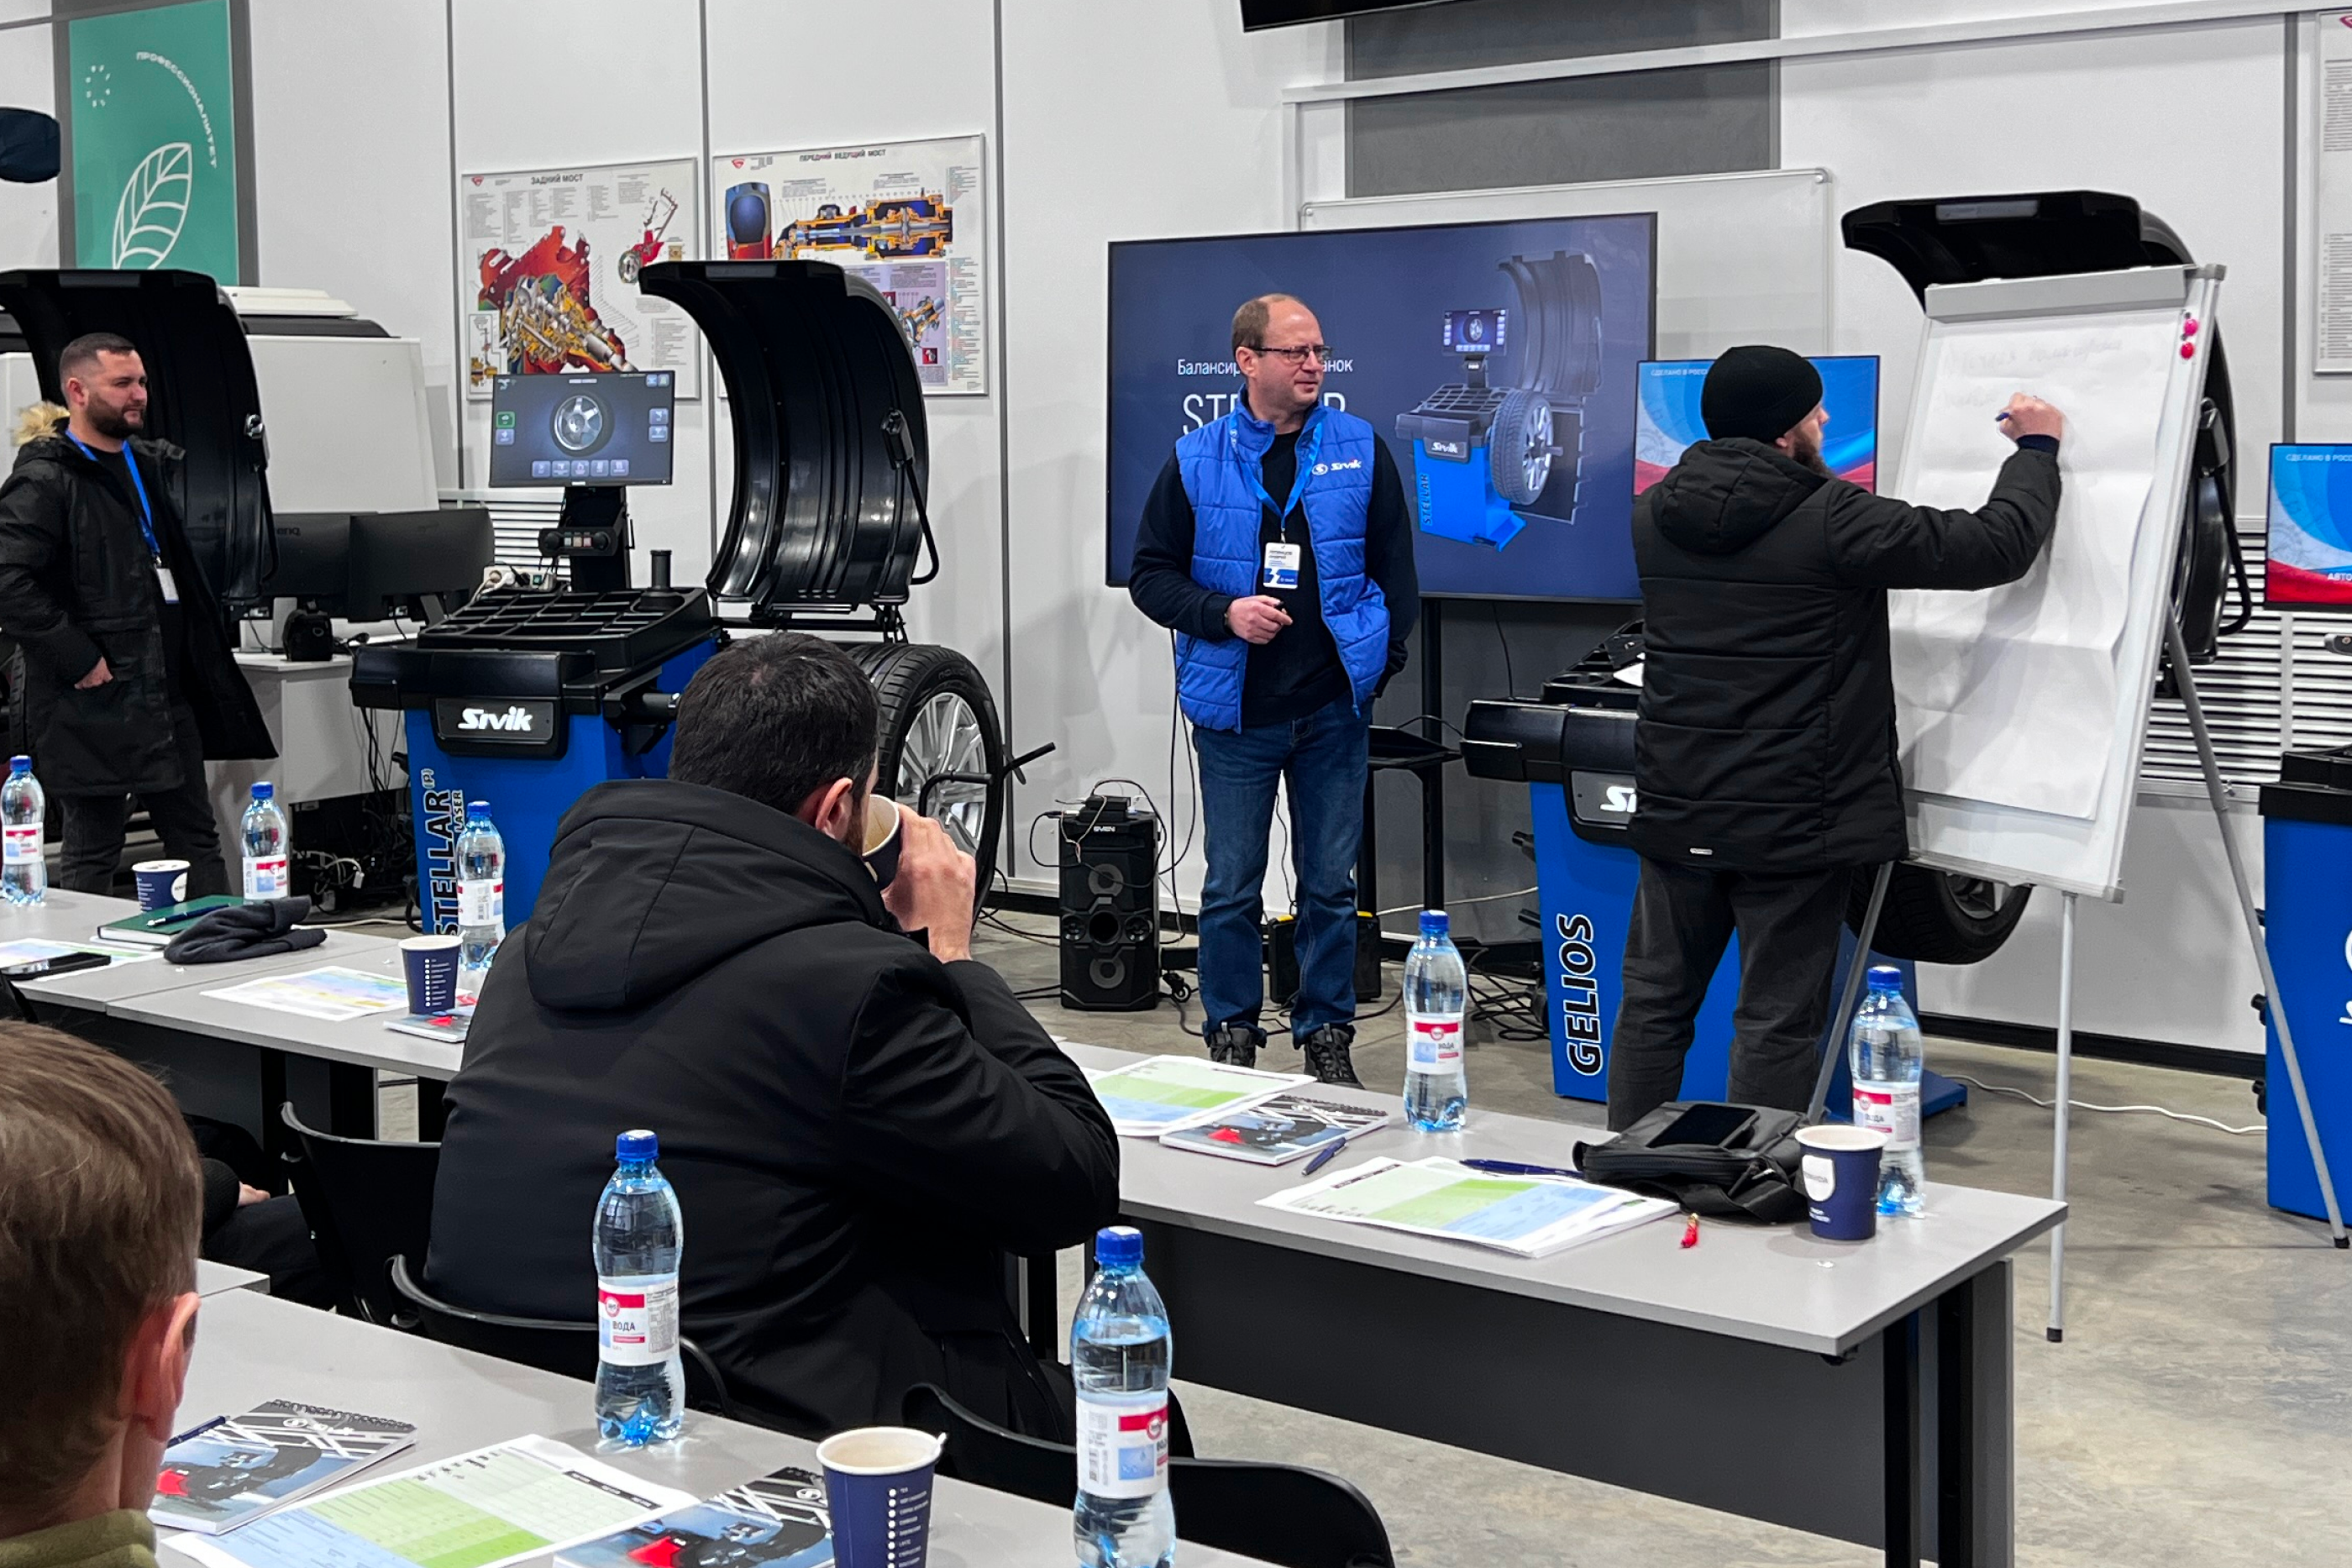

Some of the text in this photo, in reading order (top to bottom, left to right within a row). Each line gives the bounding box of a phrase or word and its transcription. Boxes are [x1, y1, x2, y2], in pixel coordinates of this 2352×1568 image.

[530, 173, 583, 185] ЗАДНИЙ МОСТ
[1420, 474, 1431, 525] STELLAR
[458, 705, 533, 732] Sivik
[453, 790, 464, 831] LASER
[1557, 913, 1604, 1076] GELIOS
[612, 1321, 636, 1331] ВОДА
